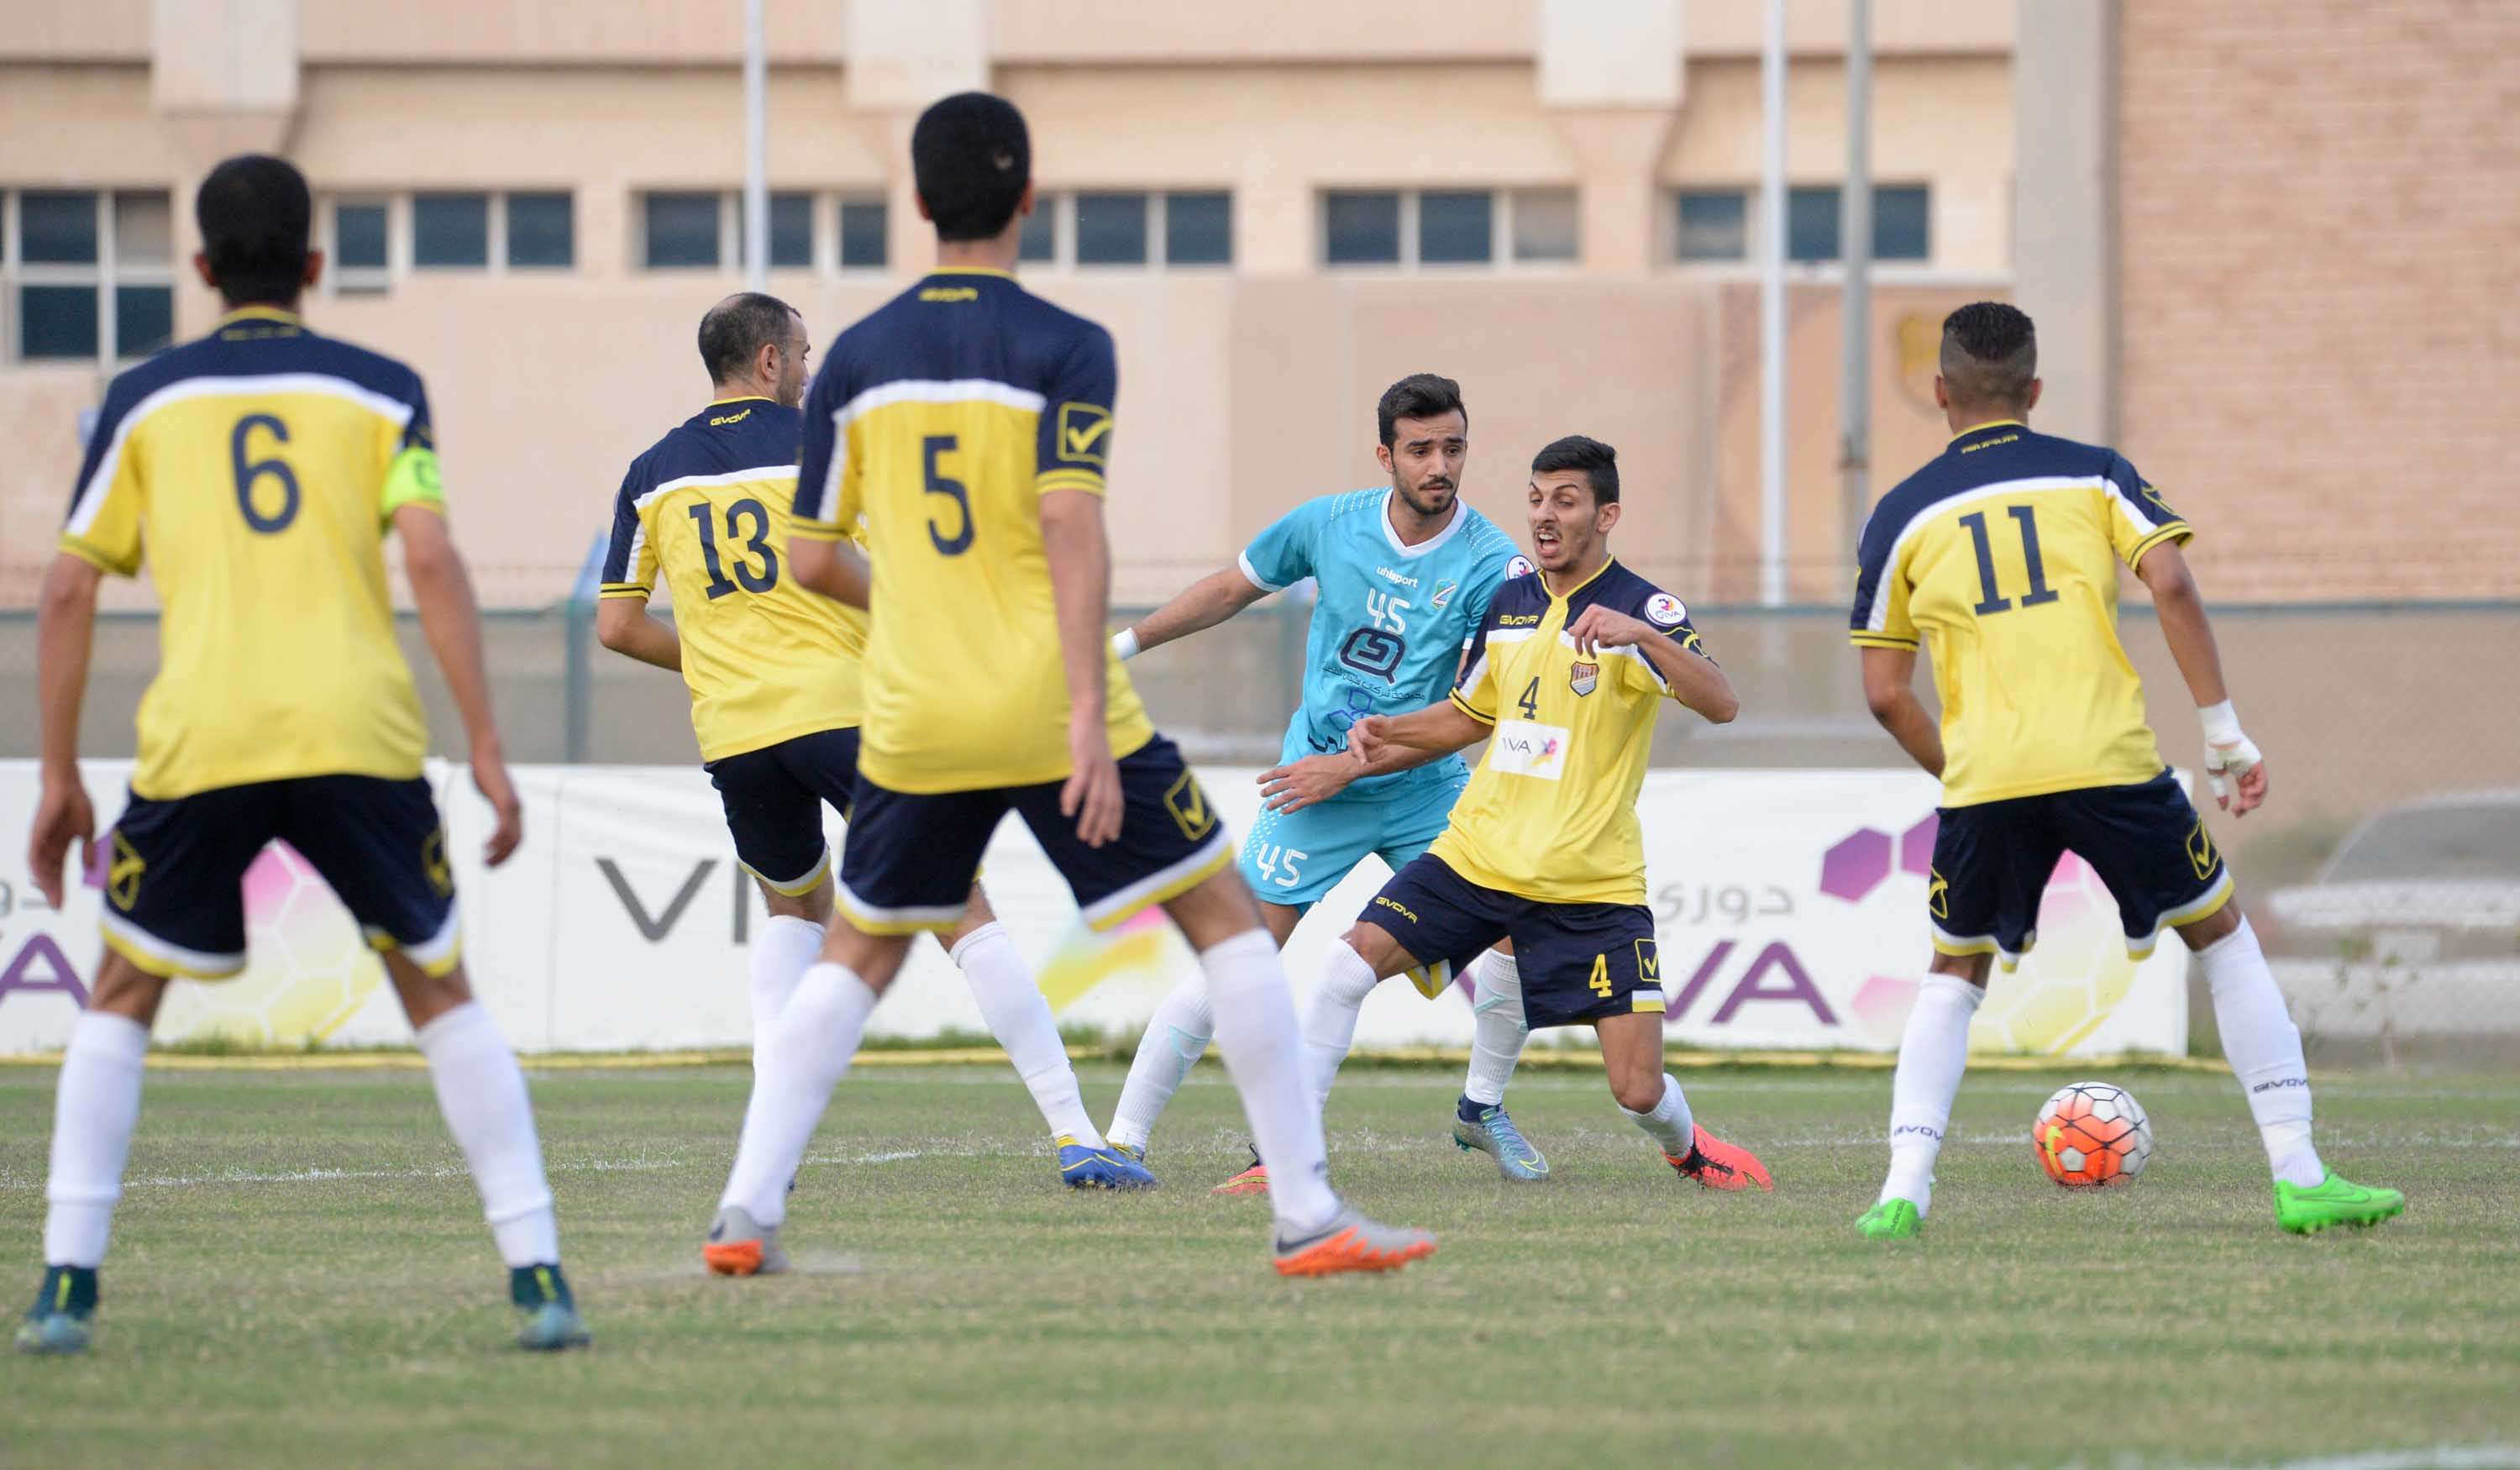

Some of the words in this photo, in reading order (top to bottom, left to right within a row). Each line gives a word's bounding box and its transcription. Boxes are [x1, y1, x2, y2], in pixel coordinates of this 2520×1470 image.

[230, 412, 301, 534] 6
[922, 434, 976, 555] 5
[687, 497, 779, 601] 13
[1959, 505, 2059, 615] 11
[1376, 565, 1419, 588] uhlsport
[1366, 588, 1411, 635] 45
[1518, 675, 1540, 721] 4
[1256, 843, 1309, 888] 45
[1588, 953, 1614, 998] 4
